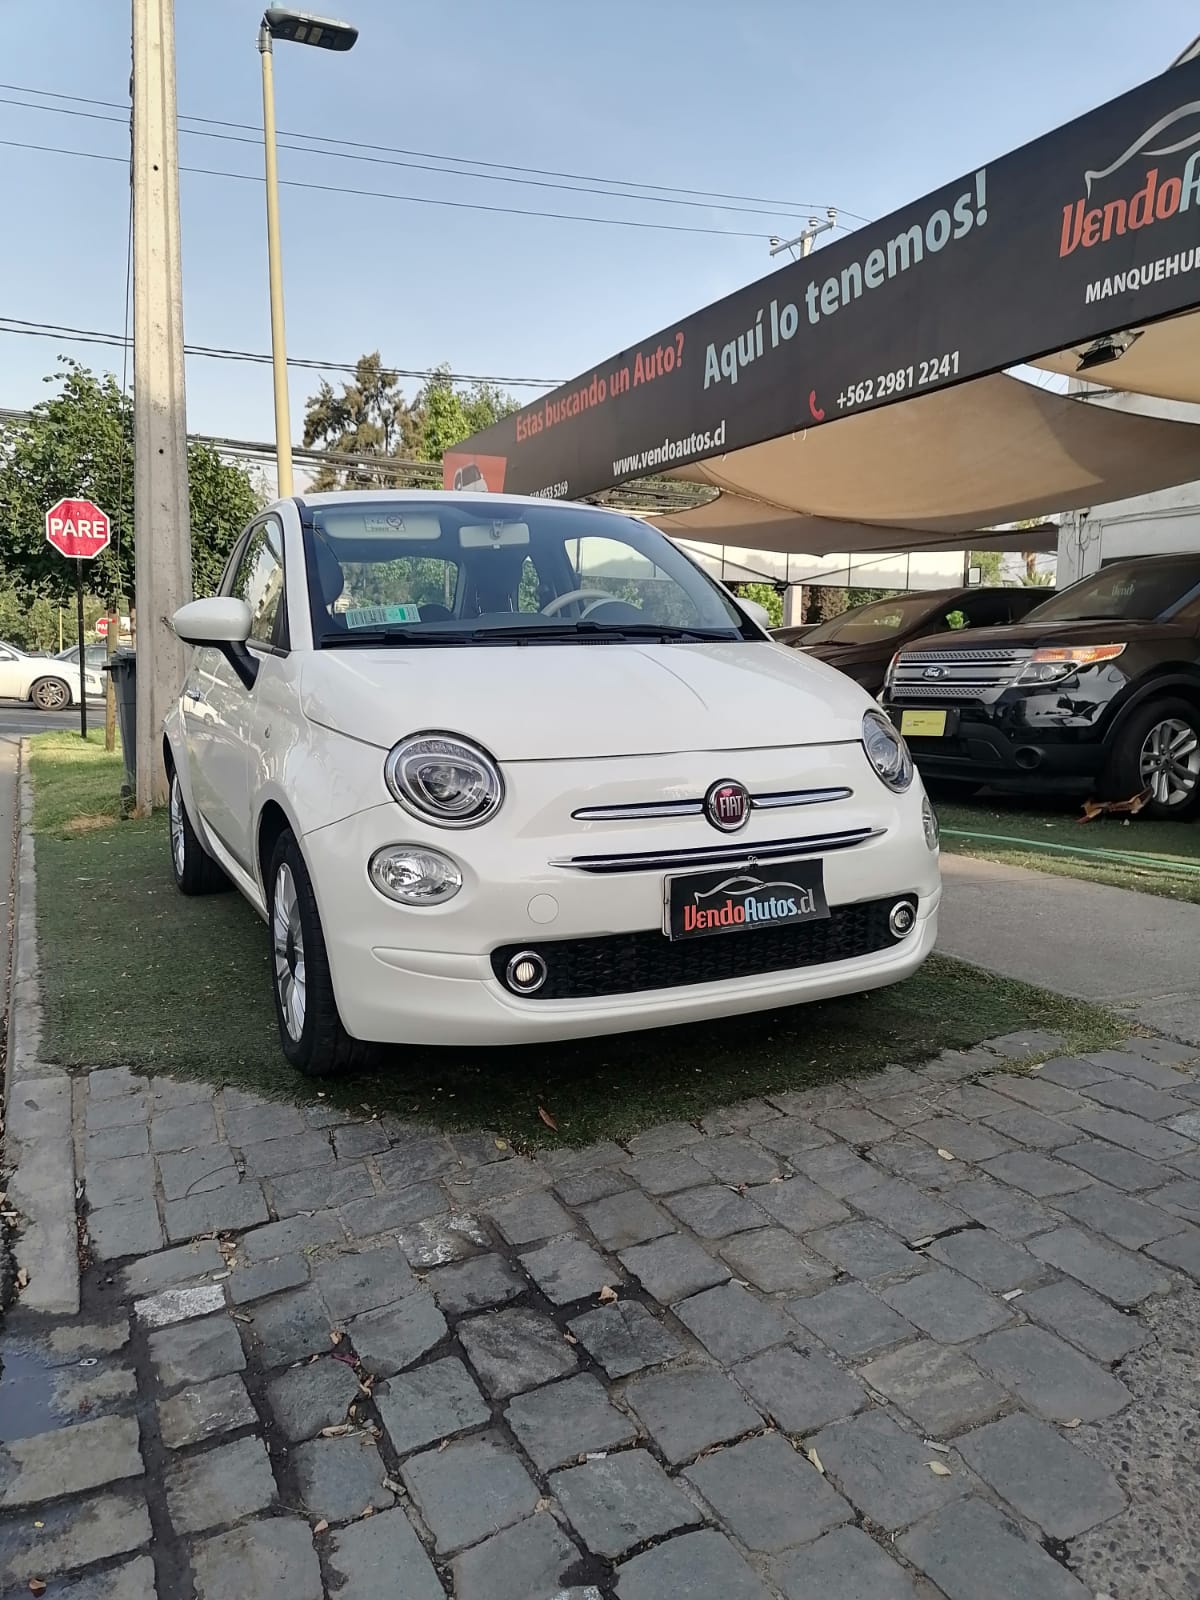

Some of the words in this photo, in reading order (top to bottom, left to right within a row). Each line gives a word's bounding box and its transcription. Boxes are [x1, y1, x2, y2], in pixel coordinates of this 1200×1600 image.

[703, 308, 764, 390] Aquí
[770, 298, 799, 349] lo
[805, 168, 988, 325] tenemos!
[516, 412, 543, 442] Estas
[545, 374, 607, 427] buscando
[609, 367, 630, 397] un
[633, 331, 685, 387] Auto?
[837, 380, 873, 409] +562
[876, 366, 914, 398] 2981
[918, 351, 960, 385] 2241
[612, 420, 726, 476] www.vendoautos.cl
[50, 518, 106, 539] PARE
[924, 666, 941, 677] Ford
[719, 795, 742, 817] FIAT
[684, 888, 816, 931] VendoAutos.cl
